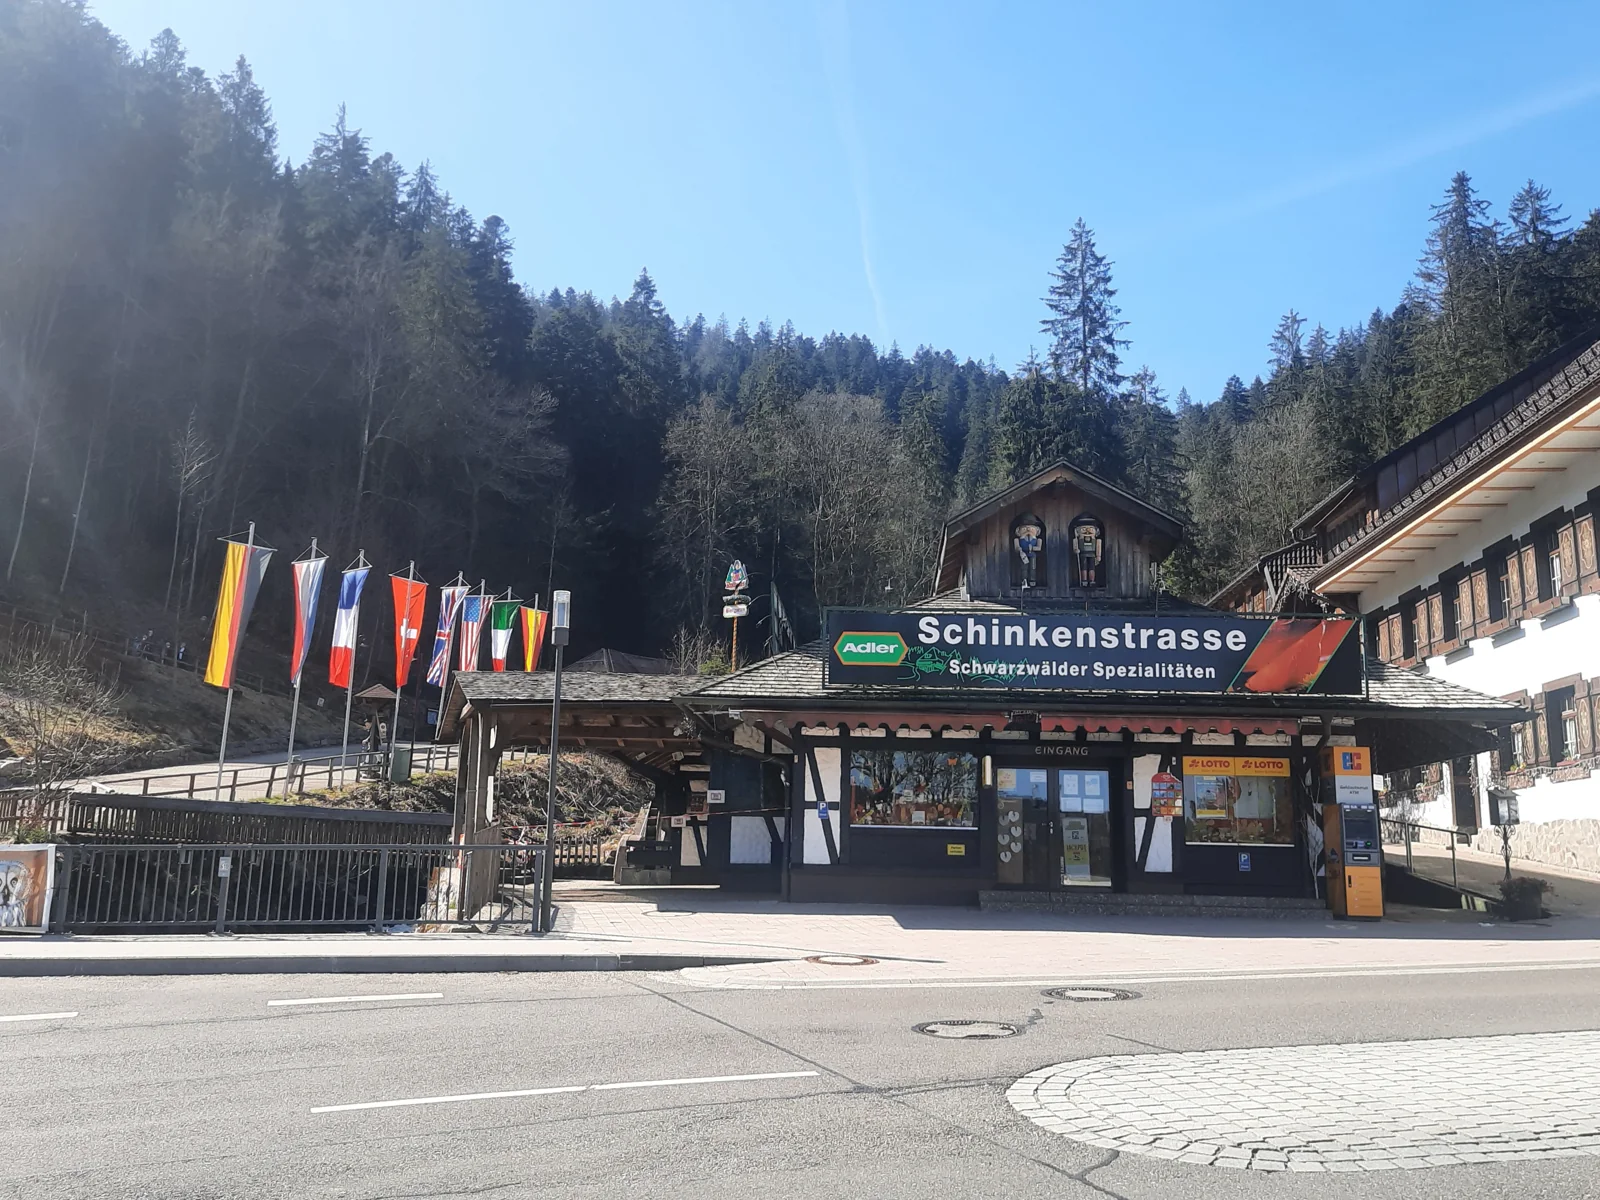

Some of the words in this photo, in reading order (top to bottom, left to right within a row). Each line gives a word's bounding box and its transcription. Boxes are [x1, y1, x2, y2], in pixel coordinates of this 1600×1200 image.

[917, 616, 1247, 651] Schinkenstrasse
[842, 642, 899, 654] Adler
[949, 659, 1088, 677] Schwarzwälder
[1093, 661, 1216, 680] Spezialitäten
[1034, 745, 1089, 756] EINGANG
[1201, 759, 1231, 769] LOTTO
[1254, 760, 1284, 769] LOTTO
[819, 802, 827, 811] P
[1240, 853, 1248, 863] P
